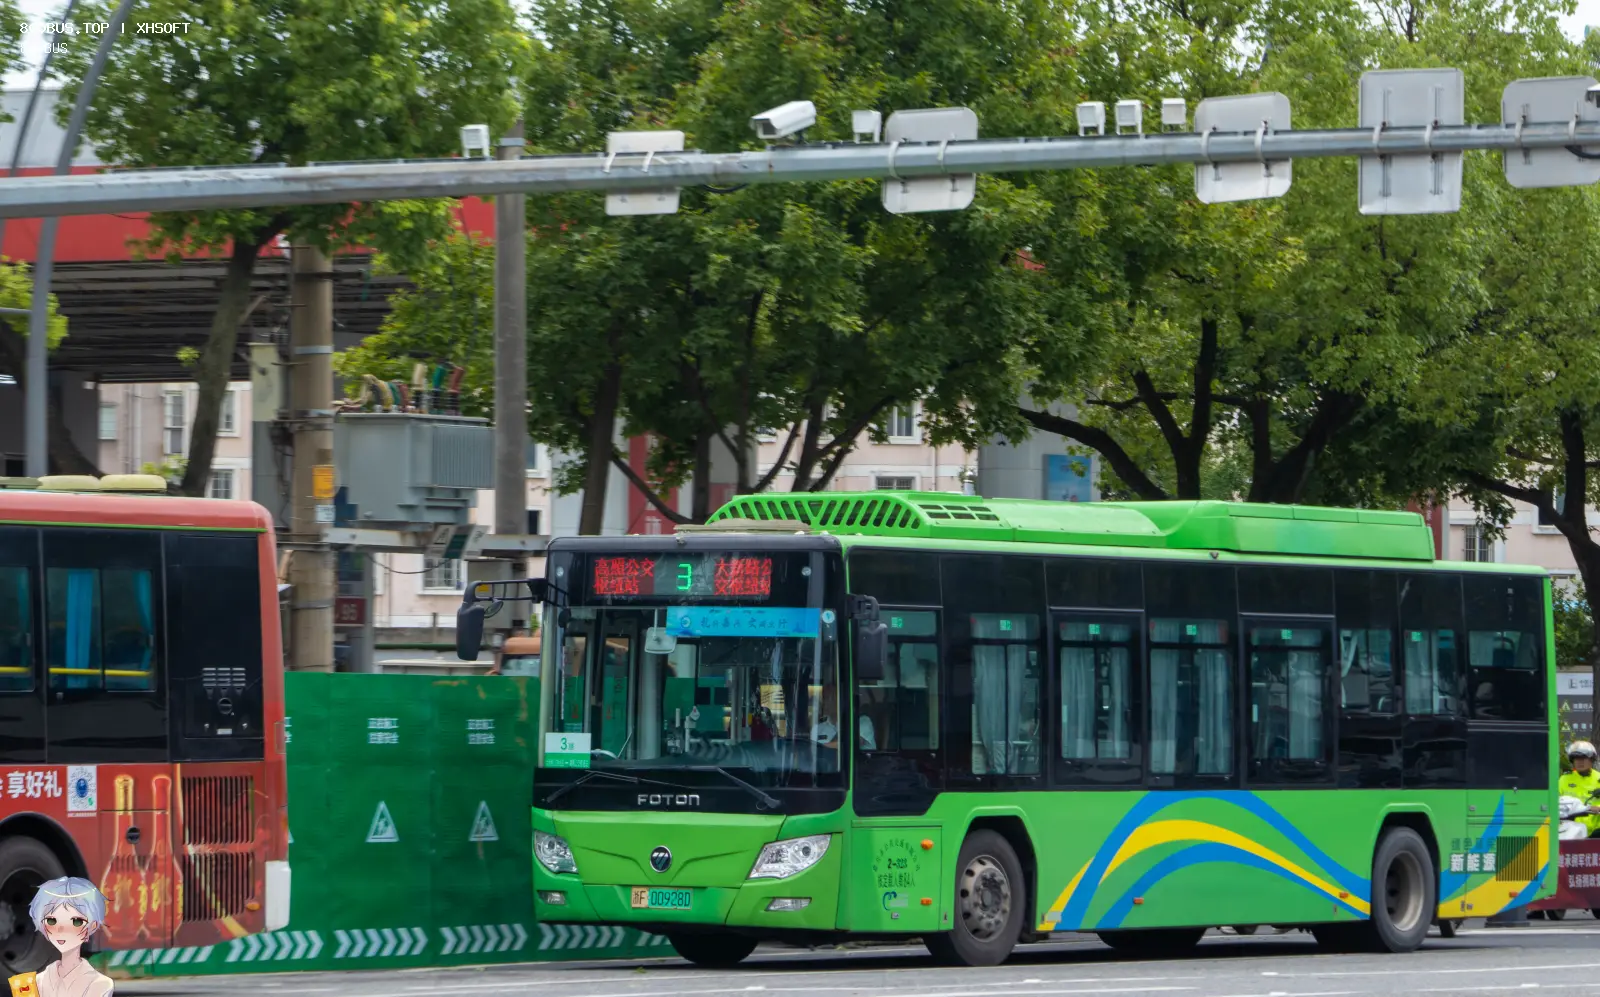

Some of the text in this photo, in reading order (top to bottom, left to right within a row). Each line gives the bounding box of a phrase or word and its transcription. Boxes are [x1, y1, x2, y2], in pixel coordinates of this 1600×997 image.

[677, 563, 693, 590] 3
[7, 770, 63, 799] 享好礼
[637, 794, 700, 806] FOTON
[1450, 853, 1496, 872] 新能源
[632, 890, 647, 905] 浙F
